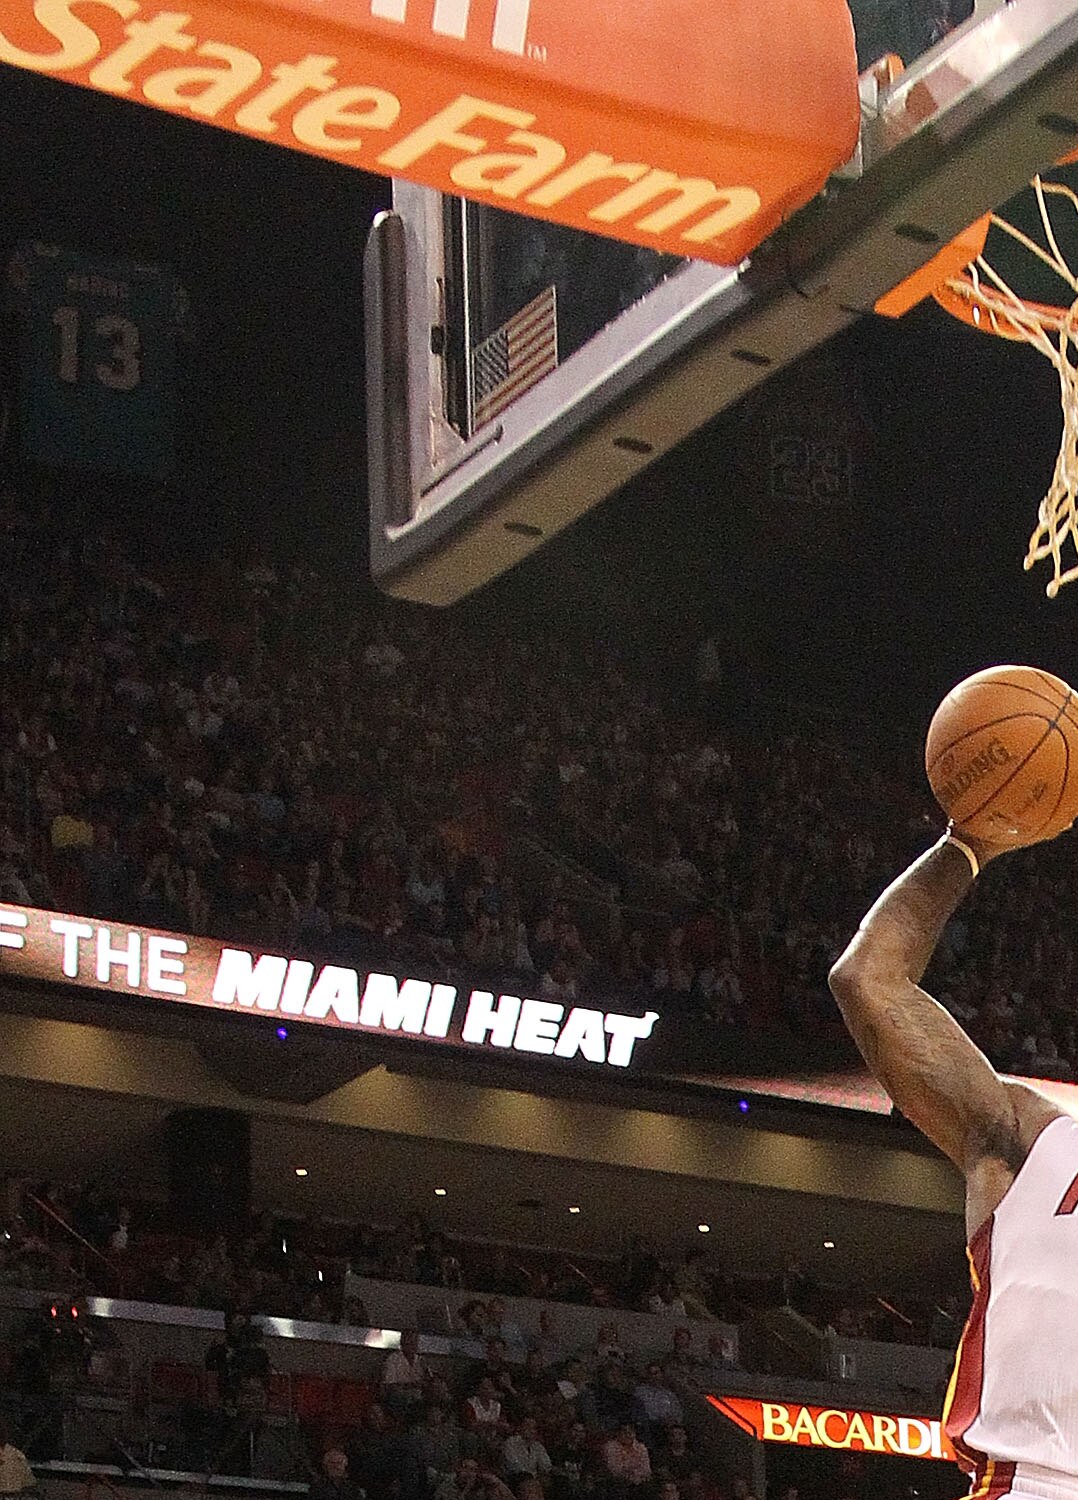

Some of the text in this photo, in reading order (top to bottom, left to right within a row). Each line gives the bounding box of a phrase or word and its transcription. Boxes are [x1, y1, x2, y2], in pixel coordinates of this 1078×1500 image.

[0, 0, 761, 244] State Farm
[52, 305, 142, 391] 13
[50, 919, 188, 997] THE
[211, 947, 457, 1038] MIAMI
[462, 989, 660, 1068] HEAT
